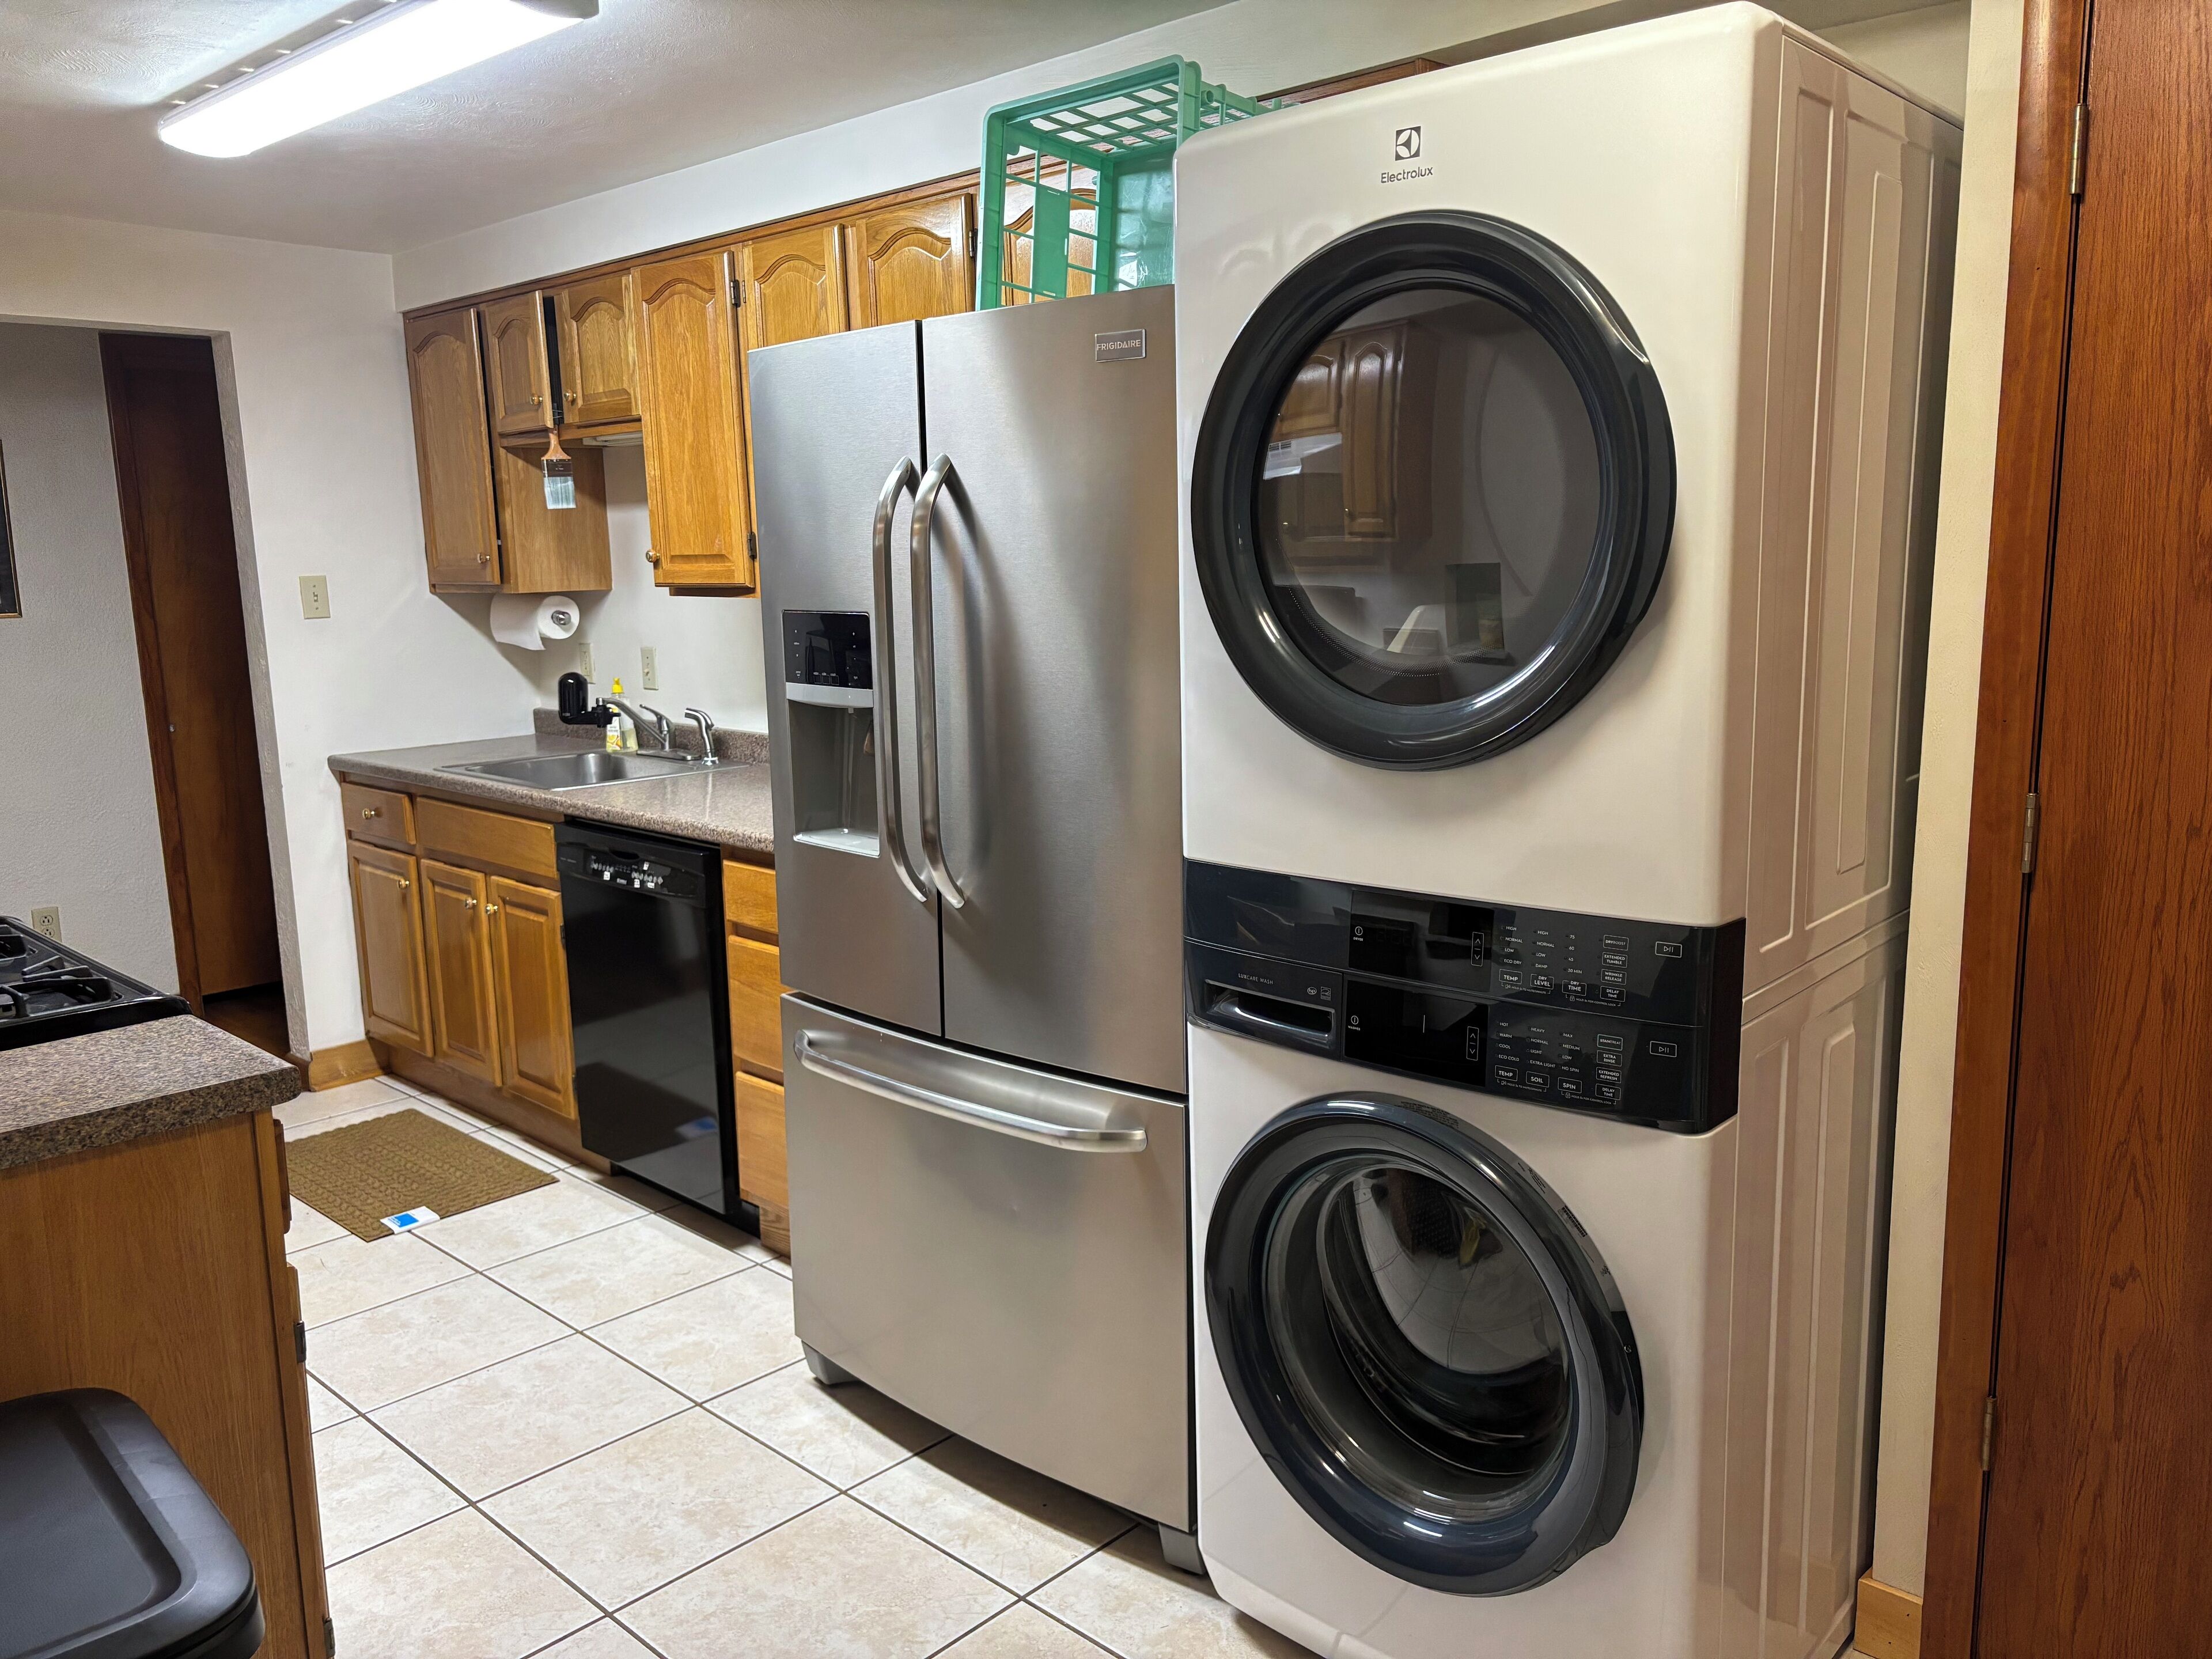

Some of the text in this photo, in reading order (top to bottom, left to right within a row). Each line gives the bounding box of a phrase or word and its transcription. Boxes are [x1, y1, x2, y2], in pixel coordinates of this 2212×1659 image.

[1381, 166, 1433, 184] Electrolux
[1096, 339, 1141, 351] FRIGIDAIRE
[1238, 973, 1258, 982] LUXCARE
